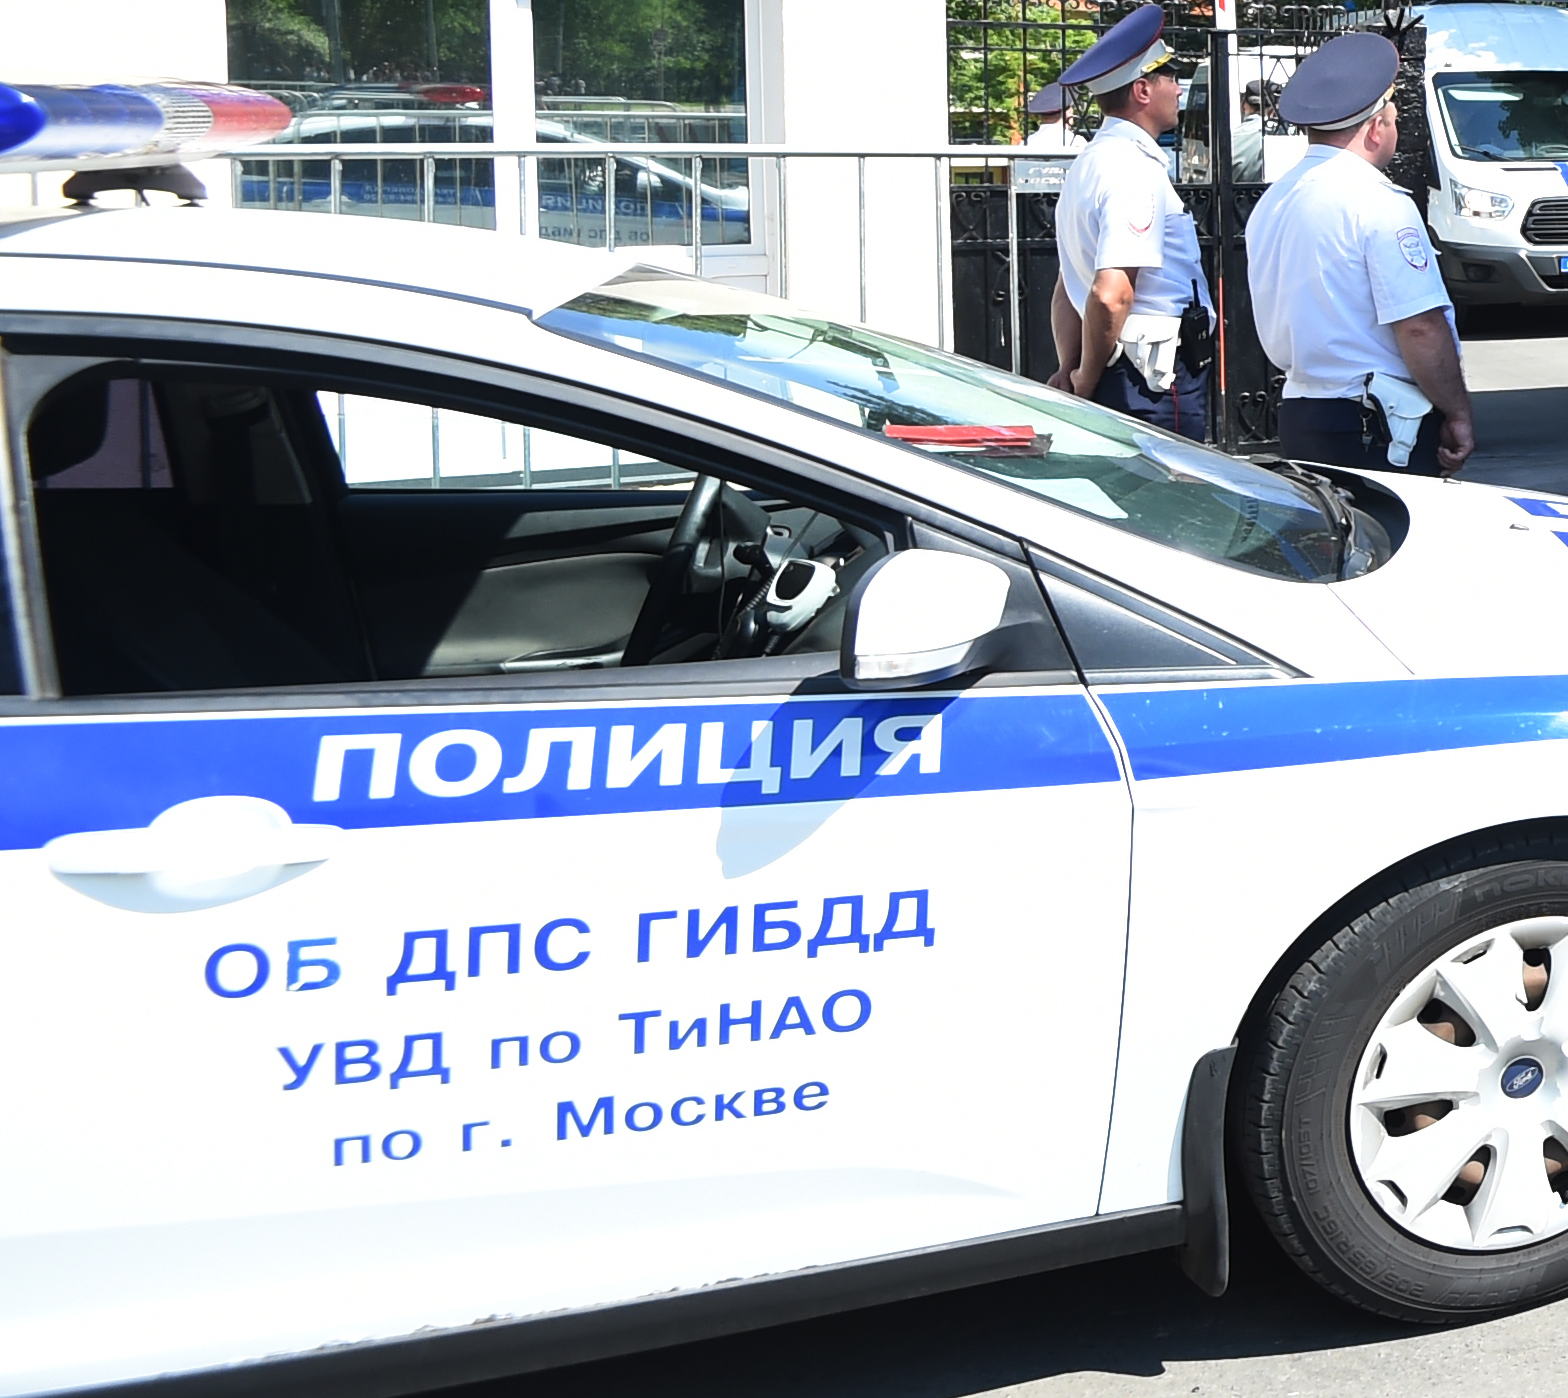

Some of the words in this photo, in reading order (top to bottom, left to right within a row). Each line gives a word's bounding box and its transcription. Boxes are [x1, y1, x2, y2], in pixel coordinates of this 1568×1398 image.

[312, 715, 943, 802] ПОЛИЦИЯ
[203, 937, 342, 999] ОБ
[386, 916, 591, 996] ДПС
[636, 888, 936, 964] ГИБДД
[276, 1030, 450, 1092] УВД
[489, 1028, 581, 1071] по
[618, 986, 873, 1057] ТиНАО
[333, 1127, 422, 1168] по
[459, 1115, 512, 1155] г.
[555, 1078, 831, 1143] Москве
